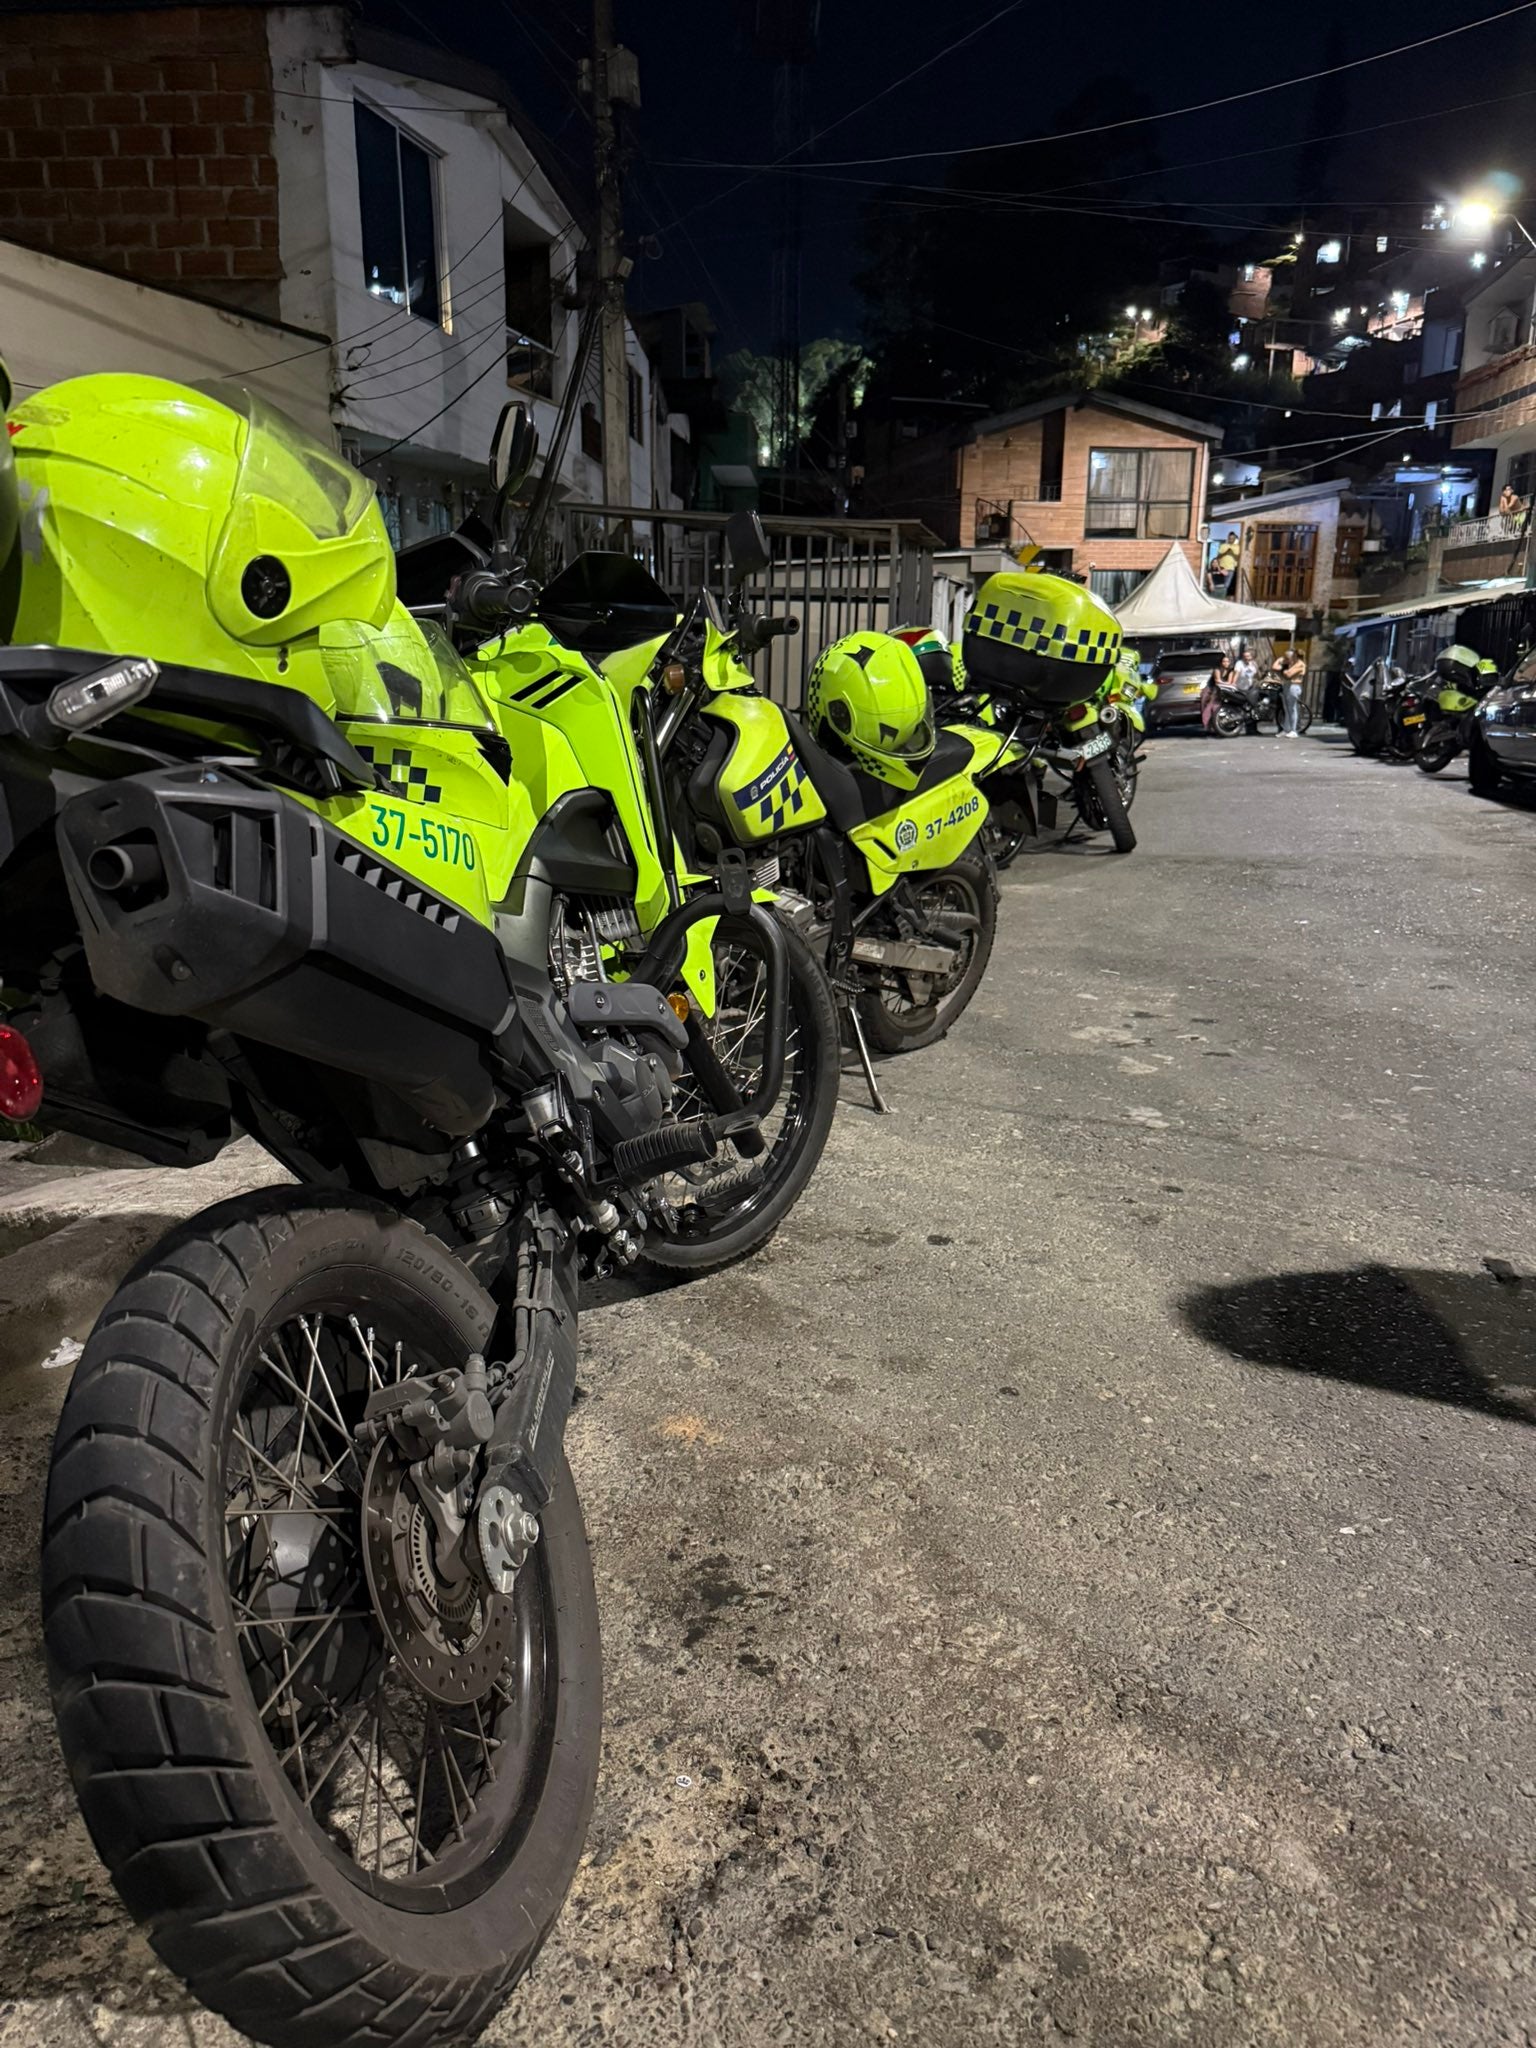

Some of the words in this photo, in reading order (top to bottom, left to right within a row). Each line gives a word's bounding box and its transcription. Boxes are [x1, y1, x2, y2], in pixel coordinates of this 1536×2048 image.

[760, 755, 789, 791] POLICÍA
[370, 804, 475, 871] 37-5170
[924, 796, 980, 840] 37-4208
